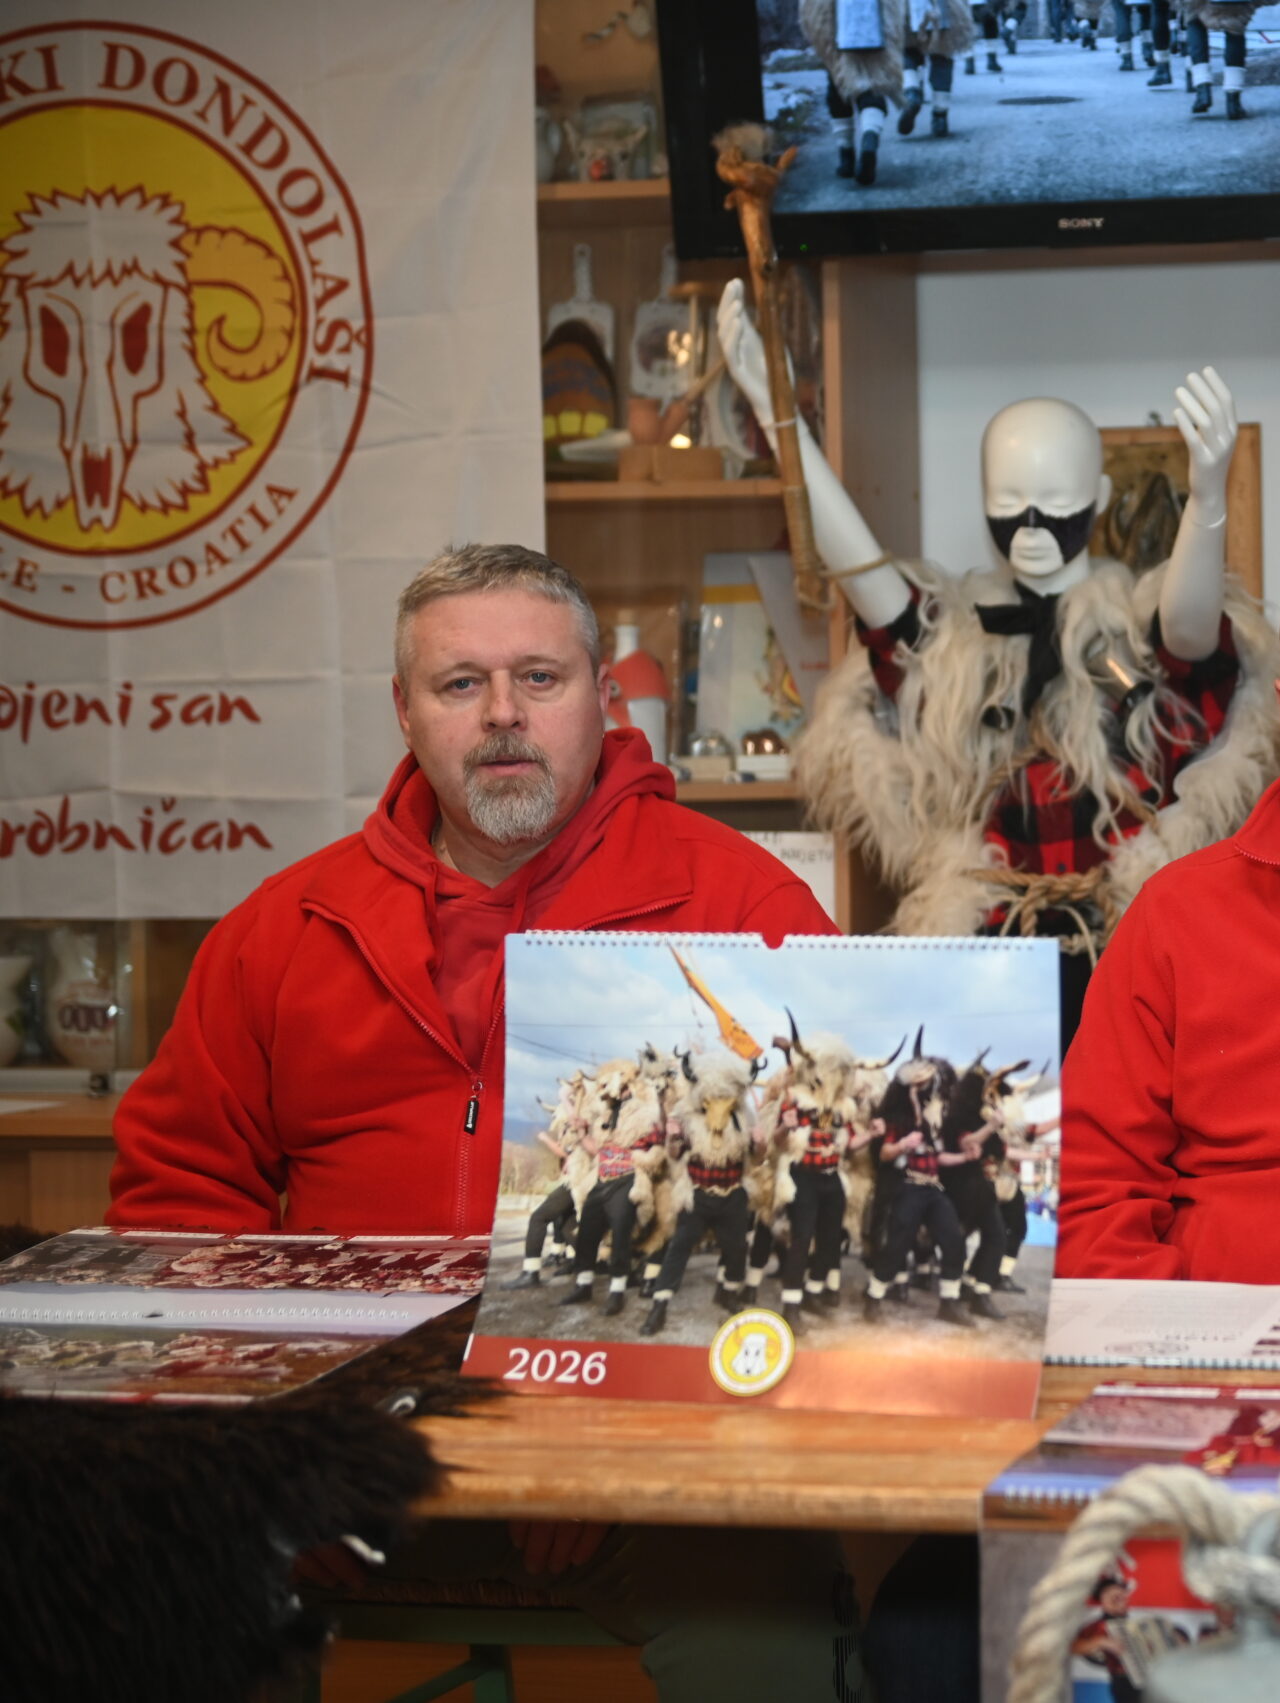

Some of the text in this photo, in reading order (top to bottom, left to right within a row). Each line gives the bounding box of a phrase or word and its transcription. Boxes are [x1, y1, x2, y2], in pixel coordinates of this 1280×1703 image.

[97, 41, 366, 390] DONDOLAŠI
[100, 482, 298, 604] CROATIA
[149, 690, 261, 732] san
[0, 795, 274, 859] robničan
[502, 1347, 608, 1385] 2026
